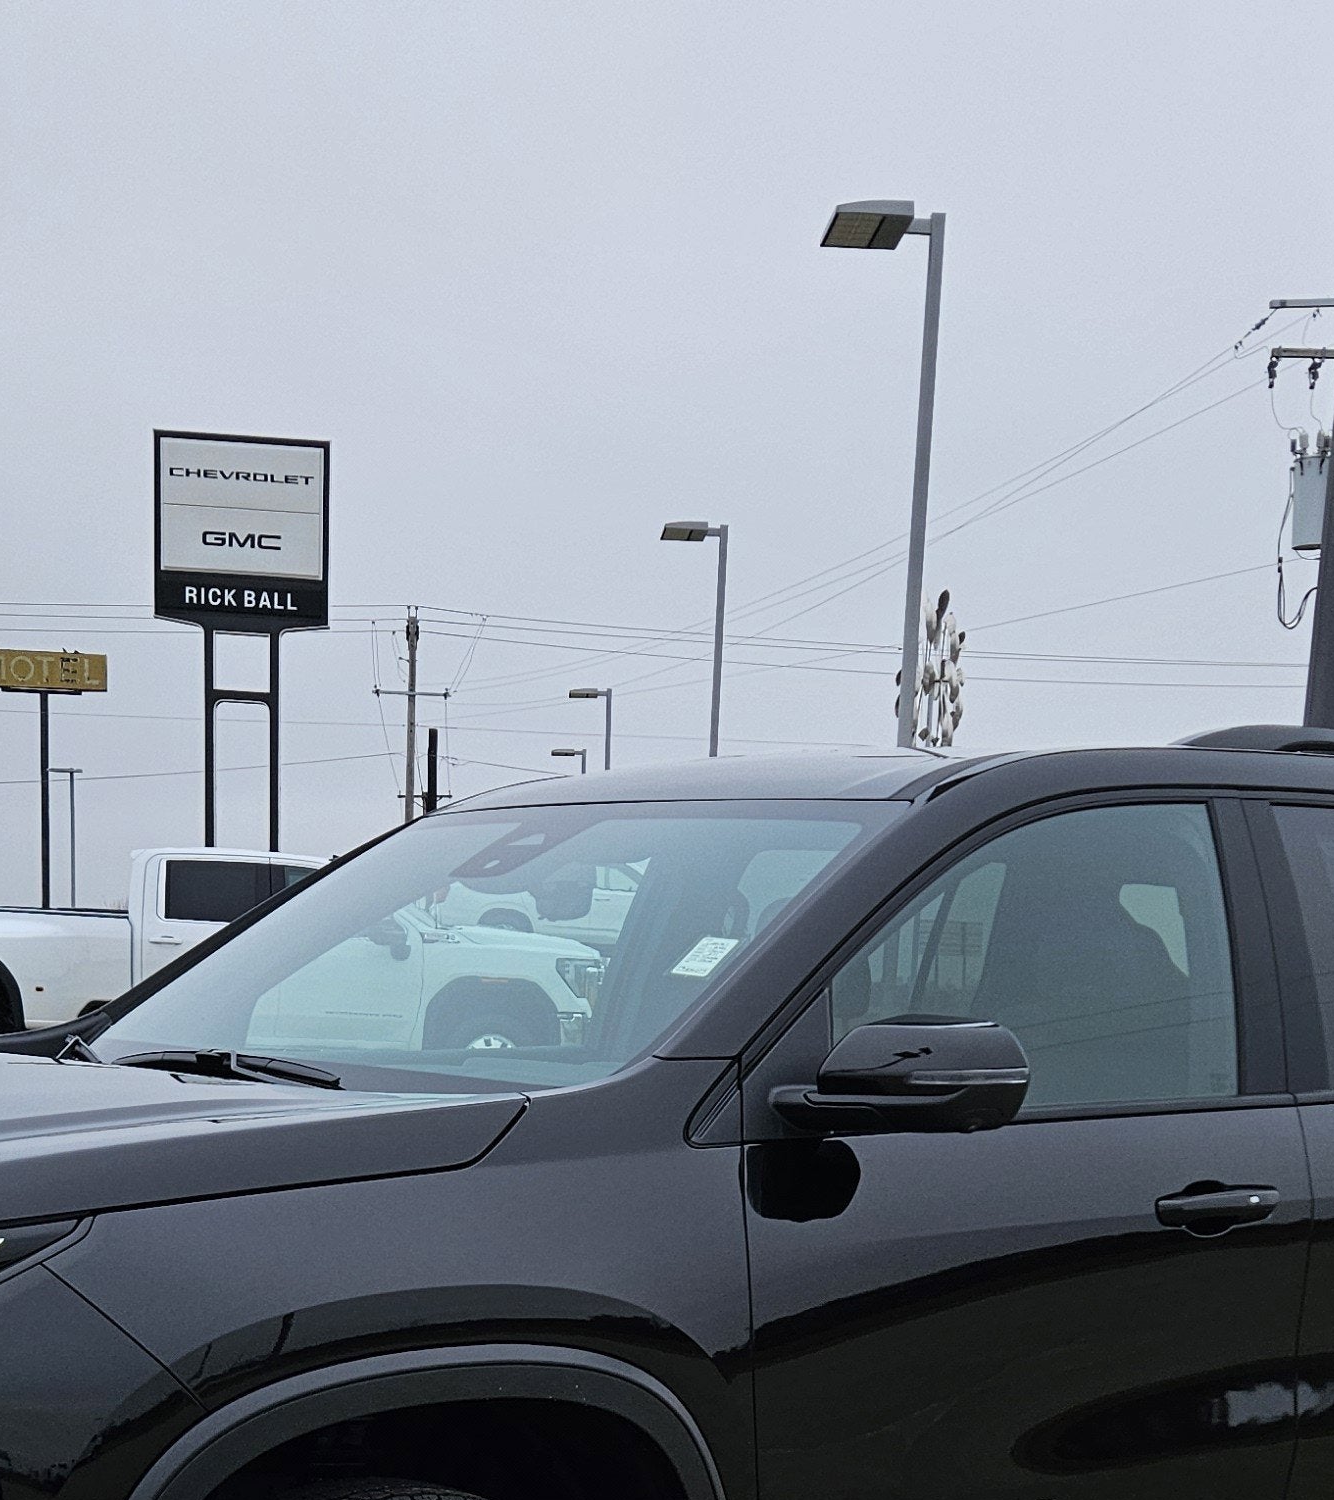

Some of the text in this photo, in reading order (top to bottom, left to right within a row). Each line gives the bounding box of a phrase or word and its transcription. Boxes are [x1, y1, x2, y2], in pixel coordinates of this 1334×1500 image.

[169, 466, 314, 486] CHEVROLET
[201, 530, 282, 551] GMC
[184, 586, 299, 611] RICK BALL
